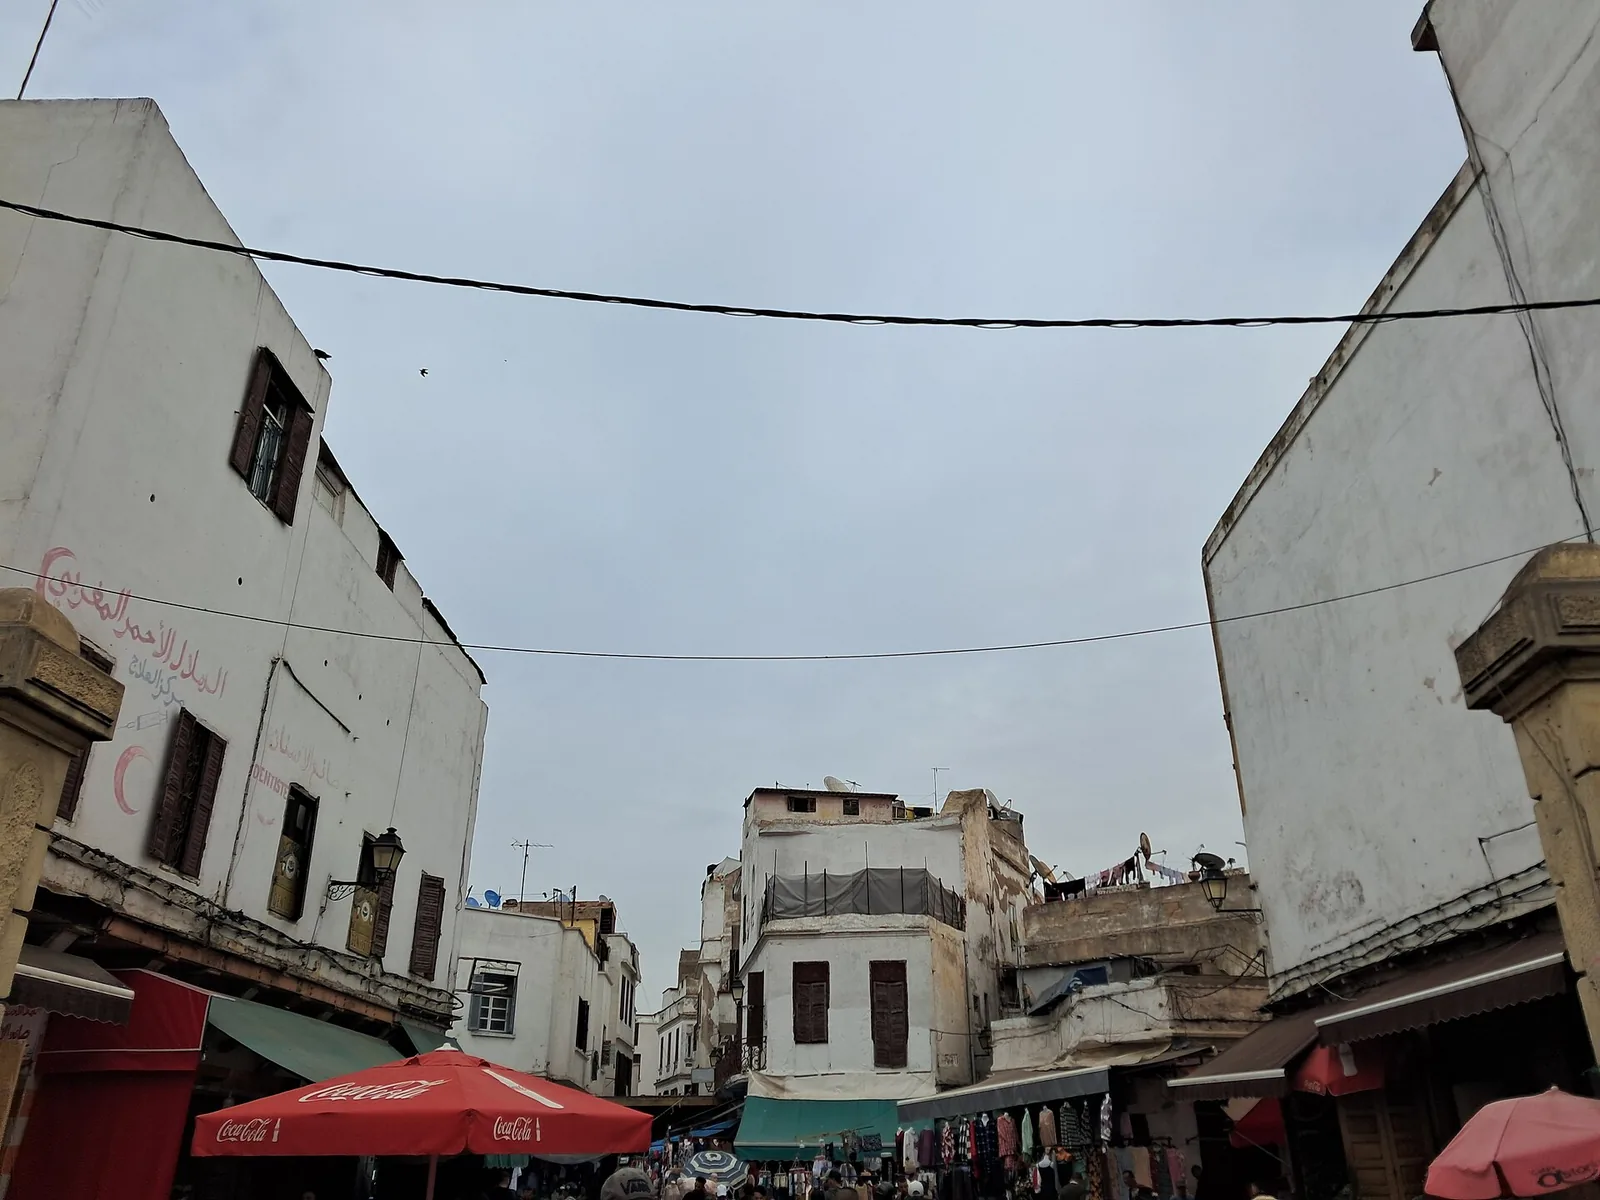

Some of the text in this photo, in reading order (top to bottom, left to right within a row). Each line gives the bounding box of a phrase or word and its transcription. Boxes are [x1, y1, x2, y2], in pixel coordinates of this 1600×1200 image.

[48, 571, 228, 699] الهلال الأحمر المغربي
[252, 764, 291, 800] DENTISTE
[298, 1078, 452, 1102] Coca-Cola
[216, 1117, 272, 1142] Coca-Cola
[493, 1116, 533, 1142] Coca-Cola
